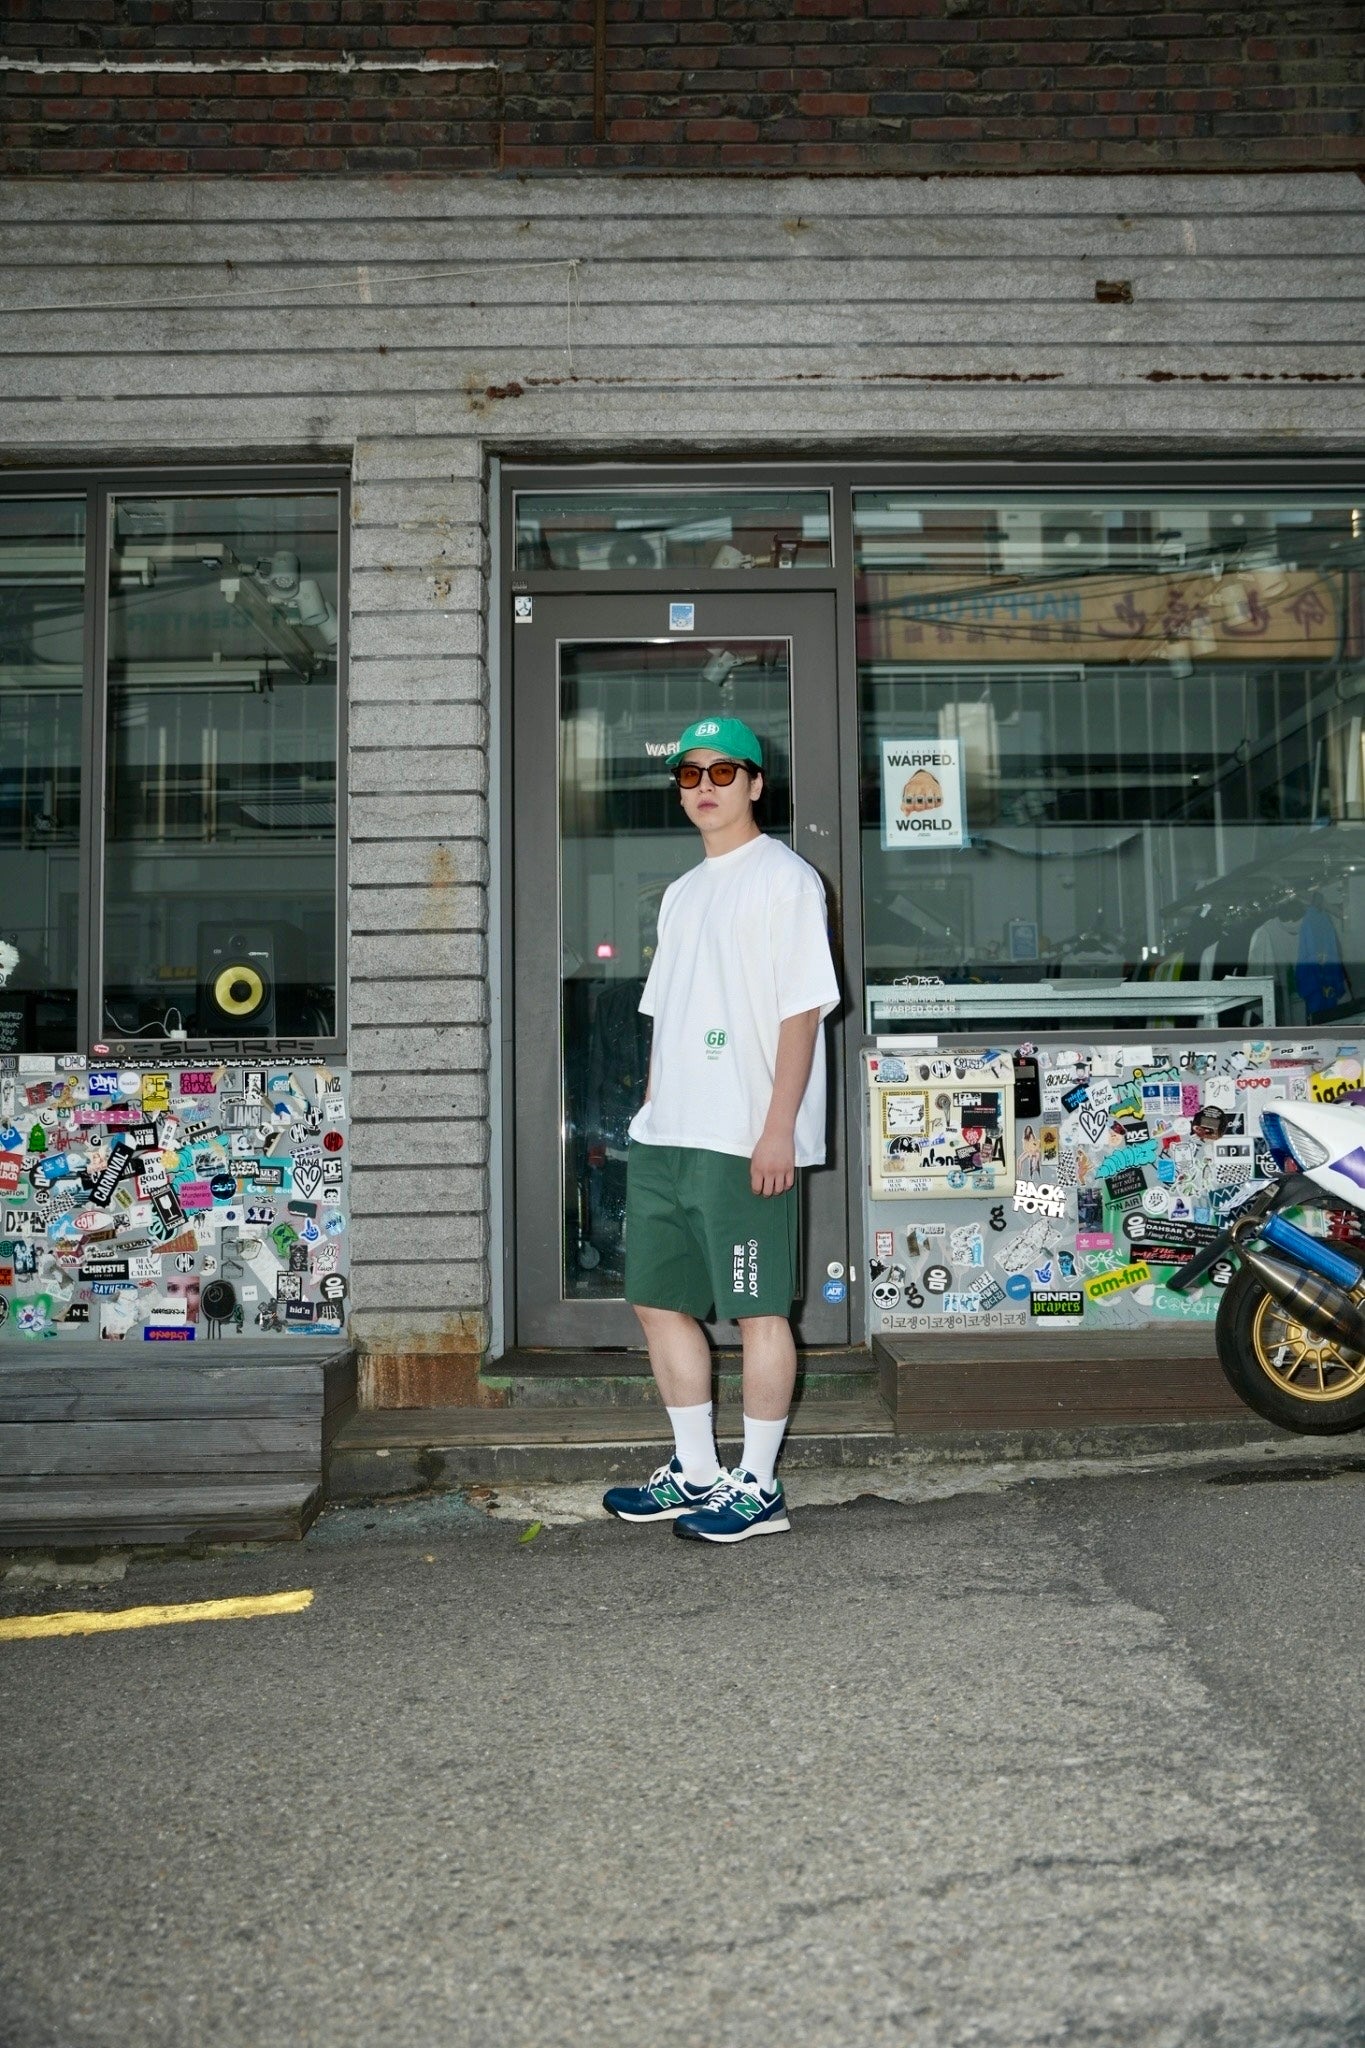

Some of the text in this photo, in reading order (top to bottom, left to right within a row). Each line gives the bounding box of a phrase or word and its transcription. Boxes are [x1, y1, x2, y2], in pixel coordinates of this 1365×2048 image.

[896, 820, 952, 831] WORLD
[707, 1031, 726, 1046] GB
[94, 1152, 128, 1201] CARNIVAL
[140, 1171, 165, 1184] good
[1014, 1196, 1065, 1218] FORTH
[1124, 1197, 1140, 1207] AIR
[1146, 1224, 1182, 1234] DAHSAR
[83, 1264, 125, 1274] CHRYSTIE
[747, 1239, 758, 1298] GOLFBOY
[1090, 1267, 1148, 1297] am-fm
[1033, 1292, 1081, 1302] IGNRD
[1034, 1301, 1080, 1314] prayers
[651, 1483, 685, 1508] N
[731, 1495, 762, 1520] N
